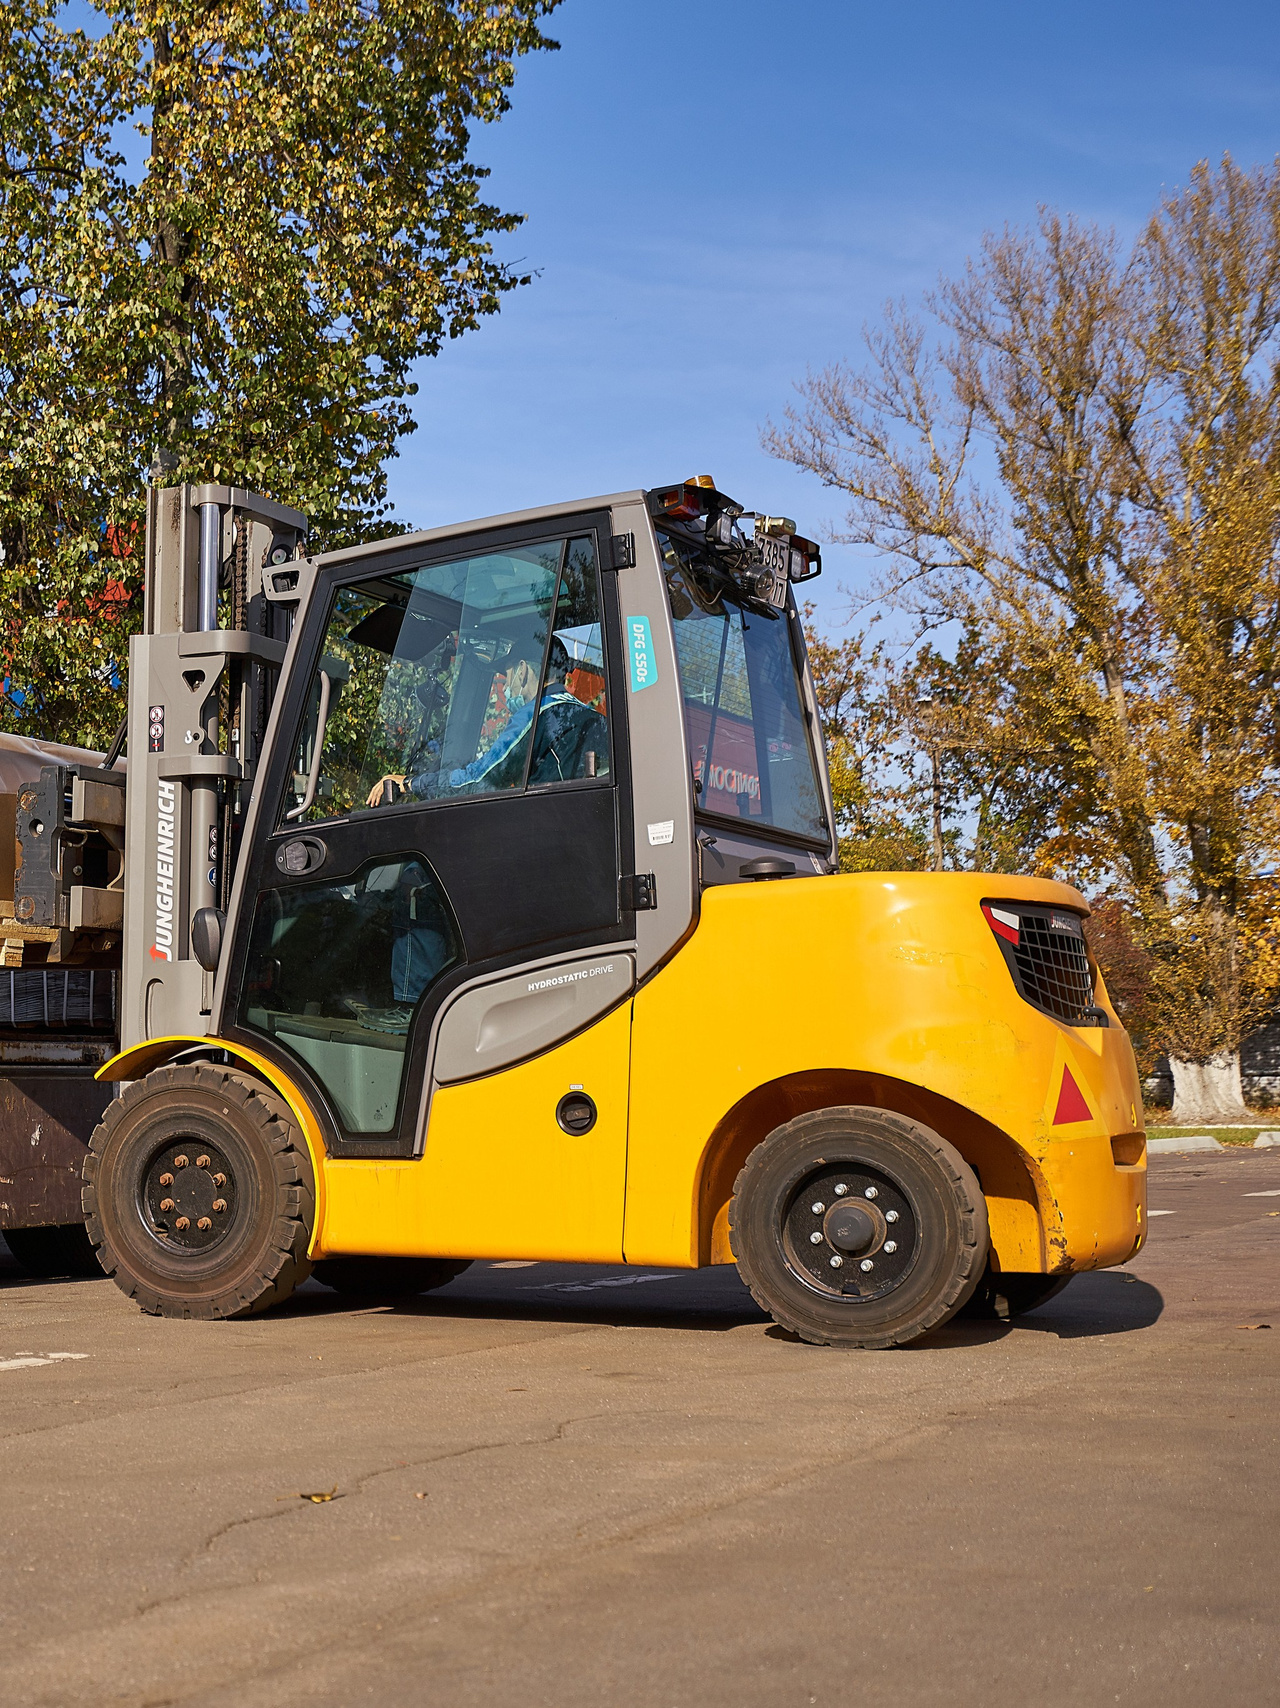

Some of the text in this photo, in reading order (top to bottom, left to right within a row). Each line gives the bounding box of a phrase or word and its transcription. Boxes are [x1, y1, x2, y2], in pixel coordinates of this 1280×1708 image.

[632, 623, 648, 683] DFG S50s
[154, 779, 176, 963] JUNGHEINRICH
[527, 964, 614, 992] HYDROSTATIC DRIVE
